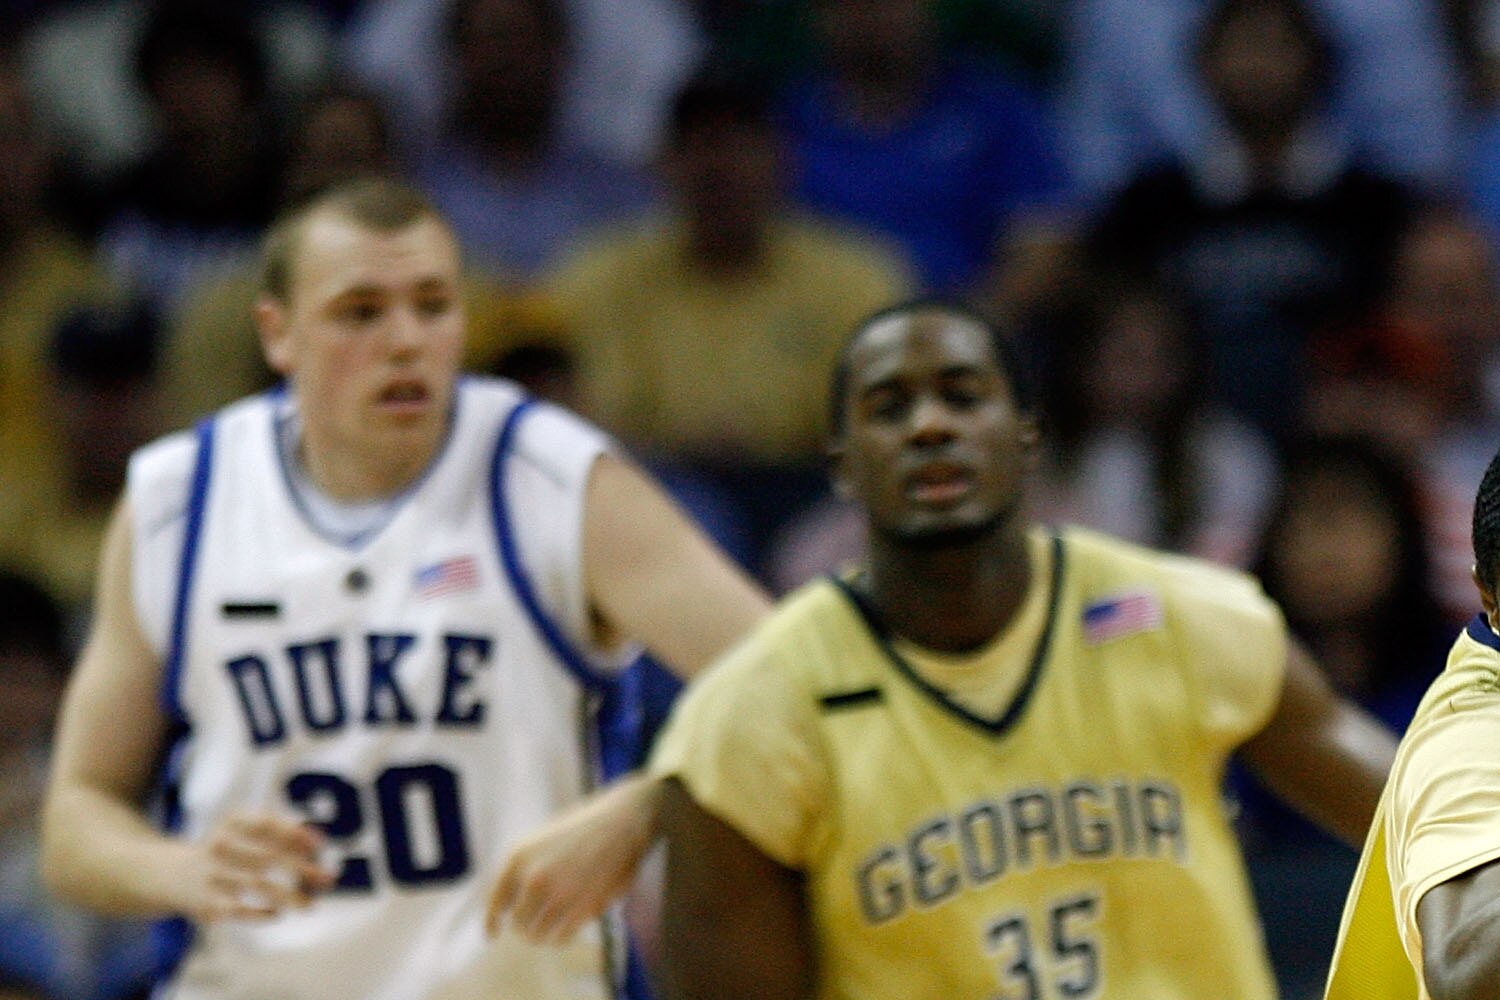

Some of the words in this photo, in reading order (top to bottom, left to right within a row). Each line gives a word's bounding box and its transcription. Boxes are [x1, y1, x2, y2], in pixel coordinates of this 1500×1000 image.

[224, 633, 494, 748] DUKE
[283, 764, 470, 894] 20
[853, 781, 1192, 926] GEORGIA
